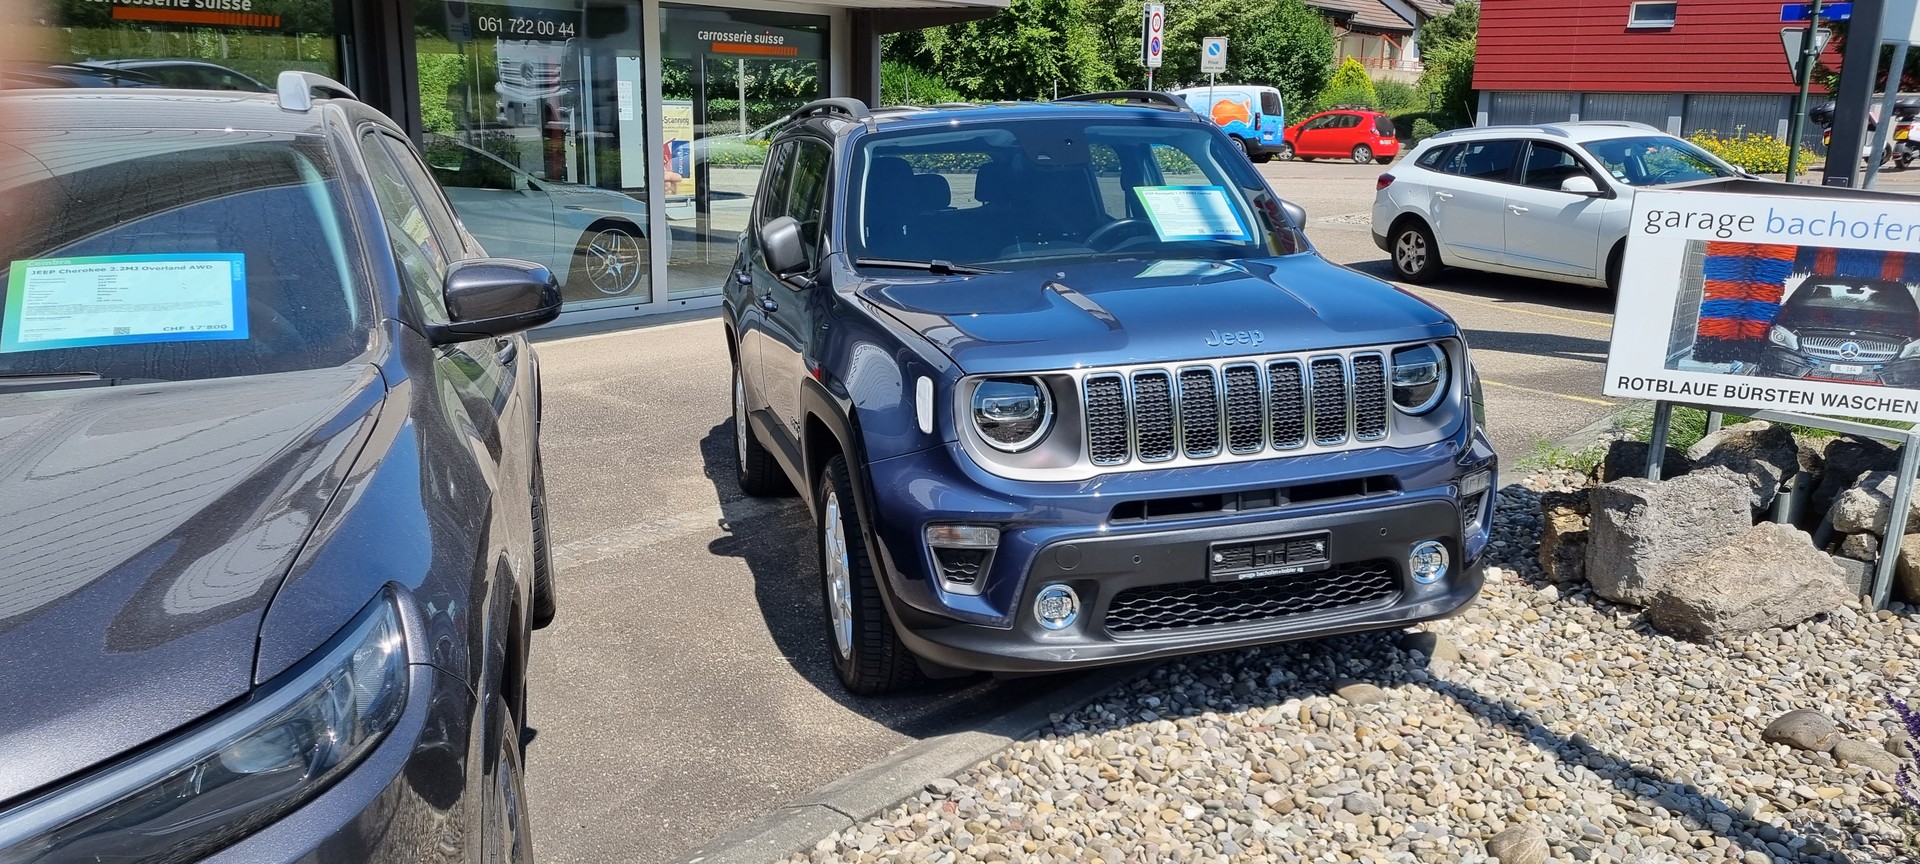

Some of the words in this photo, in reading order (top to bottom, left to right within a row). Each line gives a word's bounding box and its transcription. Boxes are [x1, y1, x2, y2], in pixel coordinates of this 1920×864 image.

[194, 0, 252, 11] suisse
[478, 16, 503, 32] 061
[508, 18, 534, 34] 722
[537, 21, 554, 36] 00
[558, 22, 575, 36] 44
[697, 30, 752, 43] carrosserie
[754, 30, 784, 45] suisse
[1644, 208, 1755, 239] garage
[1765, 207, 1920, 243] bachofen
[27, 259, 72, 267] Cembra
[58, 267, 107, 275] Cherokee
[1204, 329, 1265, 347] Jeep
[1617, 375, 1719, 399] ROTBLAUE
[1723, 383, 1815, 406] BÜRSTEN
[1820, 392, 1919, 415] WASCHEN
[1238, 572, 1256, 580] garage
